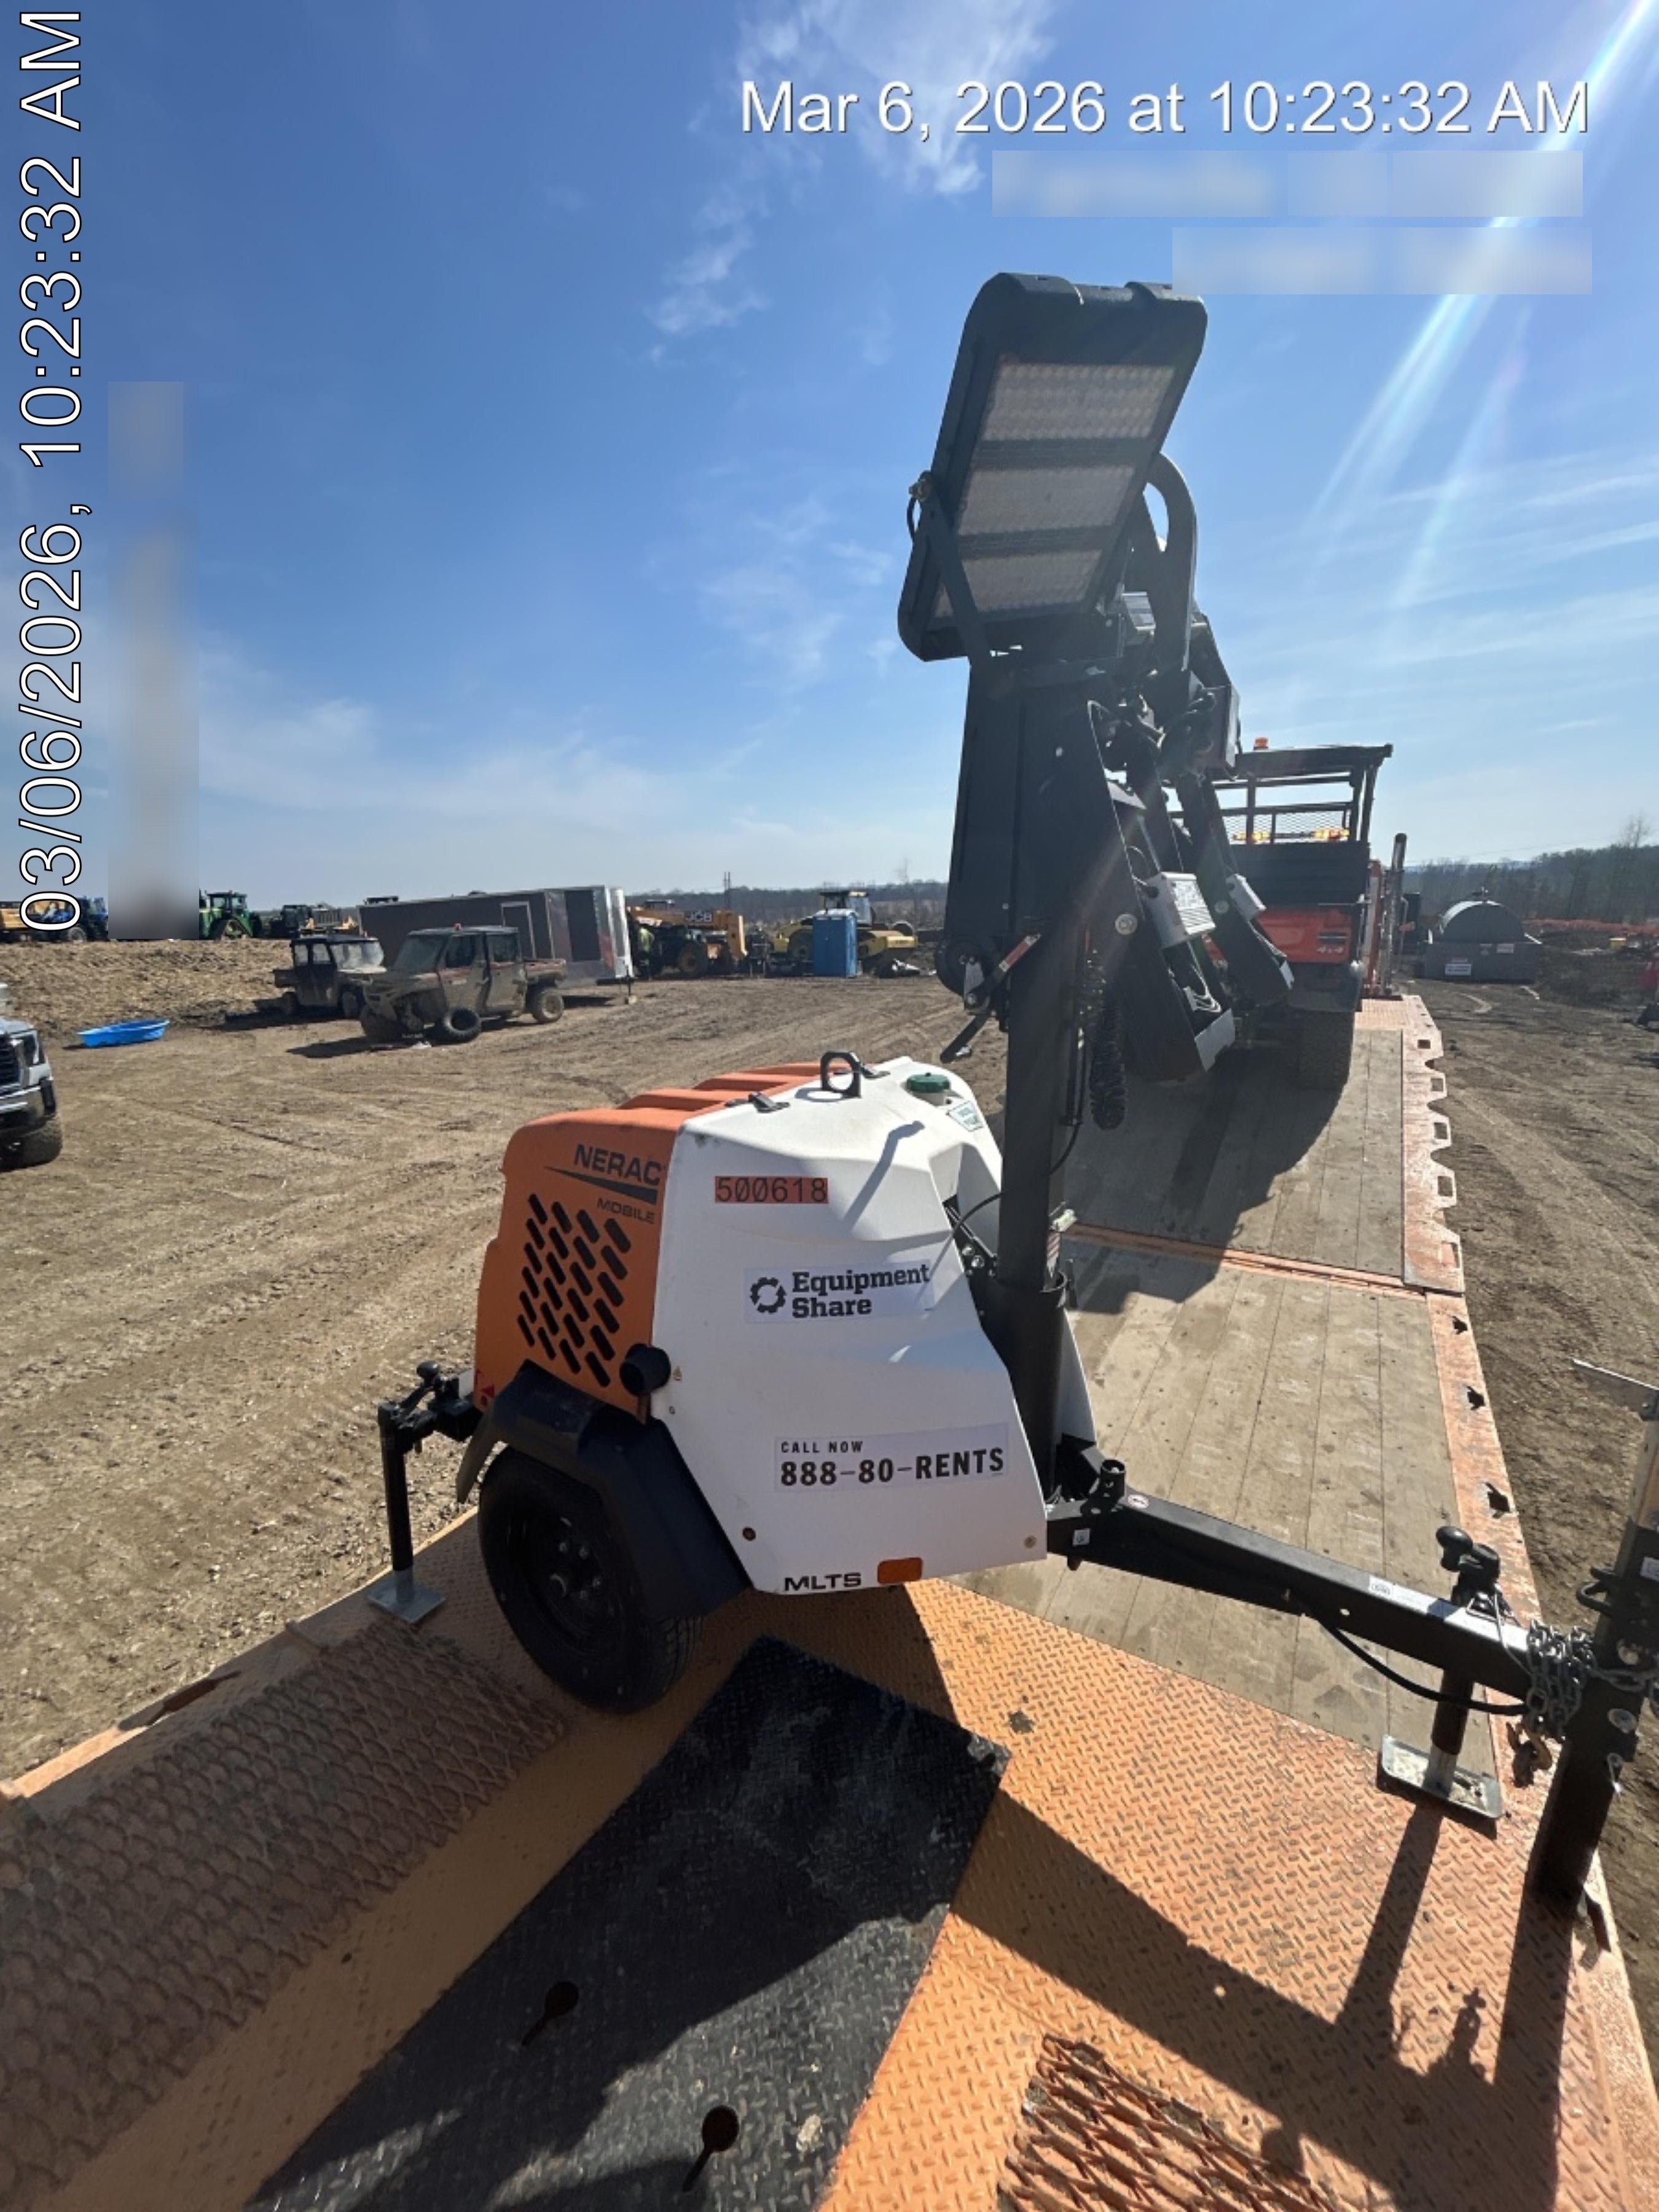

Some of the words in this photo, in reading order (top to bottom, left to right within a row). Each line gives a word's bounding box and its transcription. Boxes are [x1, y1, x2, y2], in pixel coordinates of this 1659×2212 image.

[684, 911, 712, 922] JCB
[716, 1177, 827, 1202] 500618
[597, 1197, 655, 1224] MOBILE
[791, 1264, 930, 1296] Equipment
[791, 1296, 873, 1319] Share
[780, 1441, 820, 1453] CALL
[828, 1440, 863, 1453] NOW
[780, 1447, 1004, 1486] 888-80-RENTS
[784, 1572, 862, 1591] MLTS
